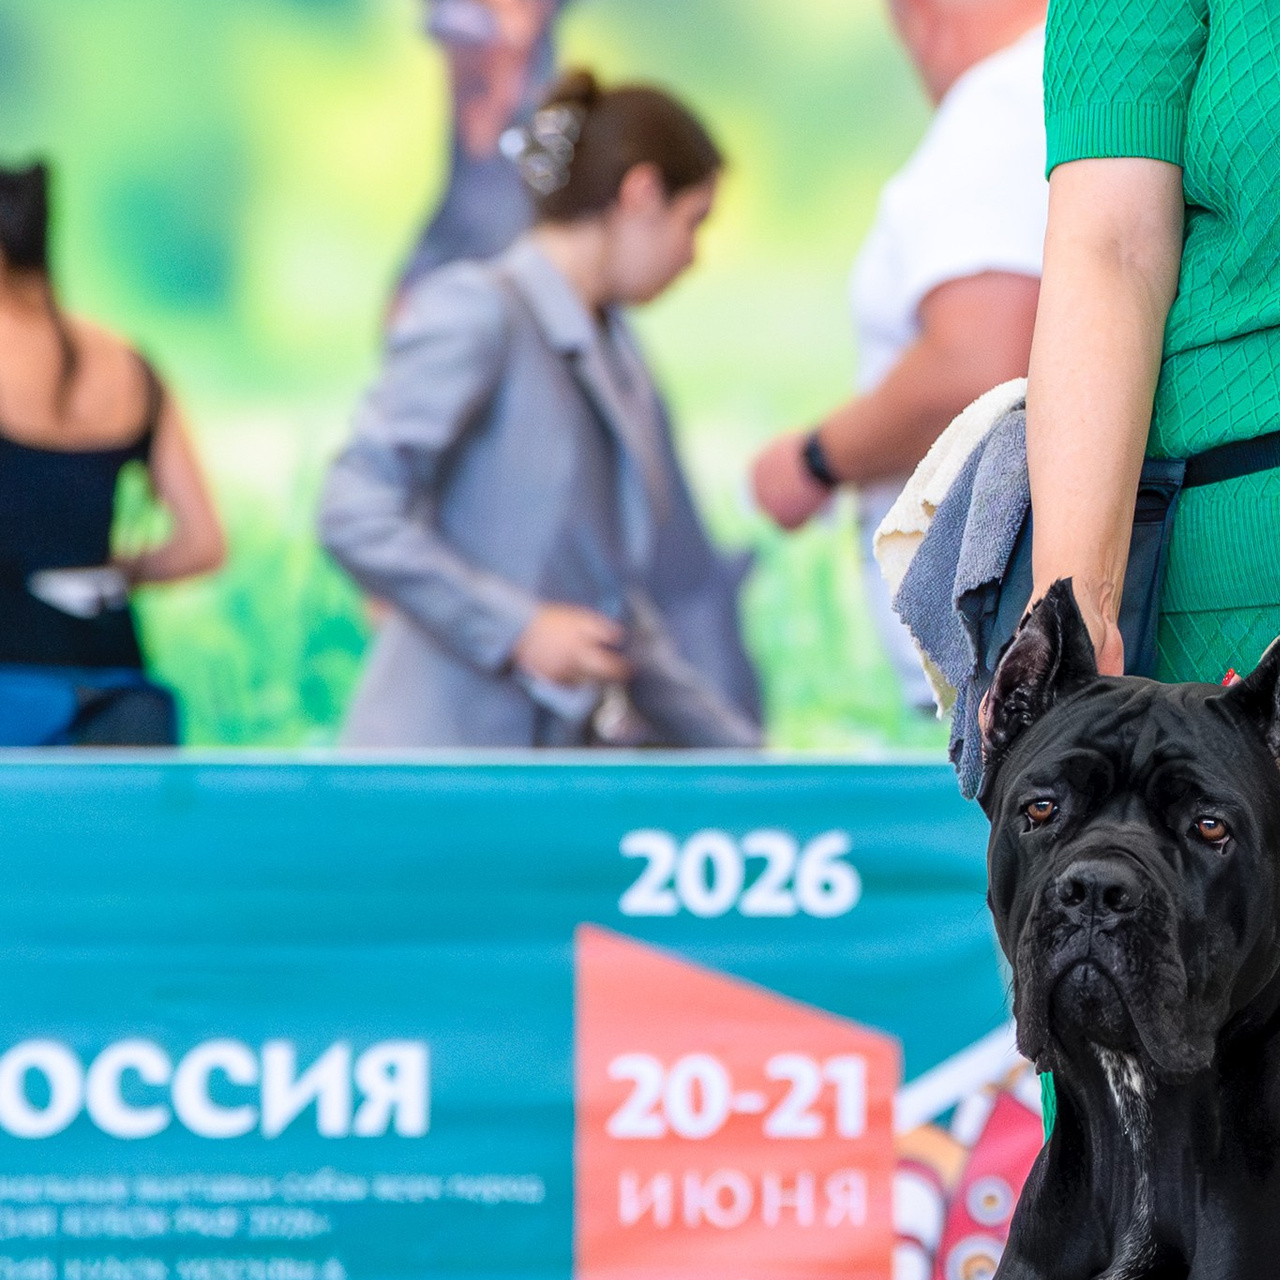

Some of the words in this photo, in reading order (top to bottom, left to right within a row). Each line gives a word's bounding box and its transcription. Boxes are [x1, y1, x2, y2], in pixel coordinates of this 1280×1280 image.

[618, 830, 861, 917] 2026
[607, 1053, 868, 1139] 20-21
[619, 1170, 868, 1229] ИЮНЯ
